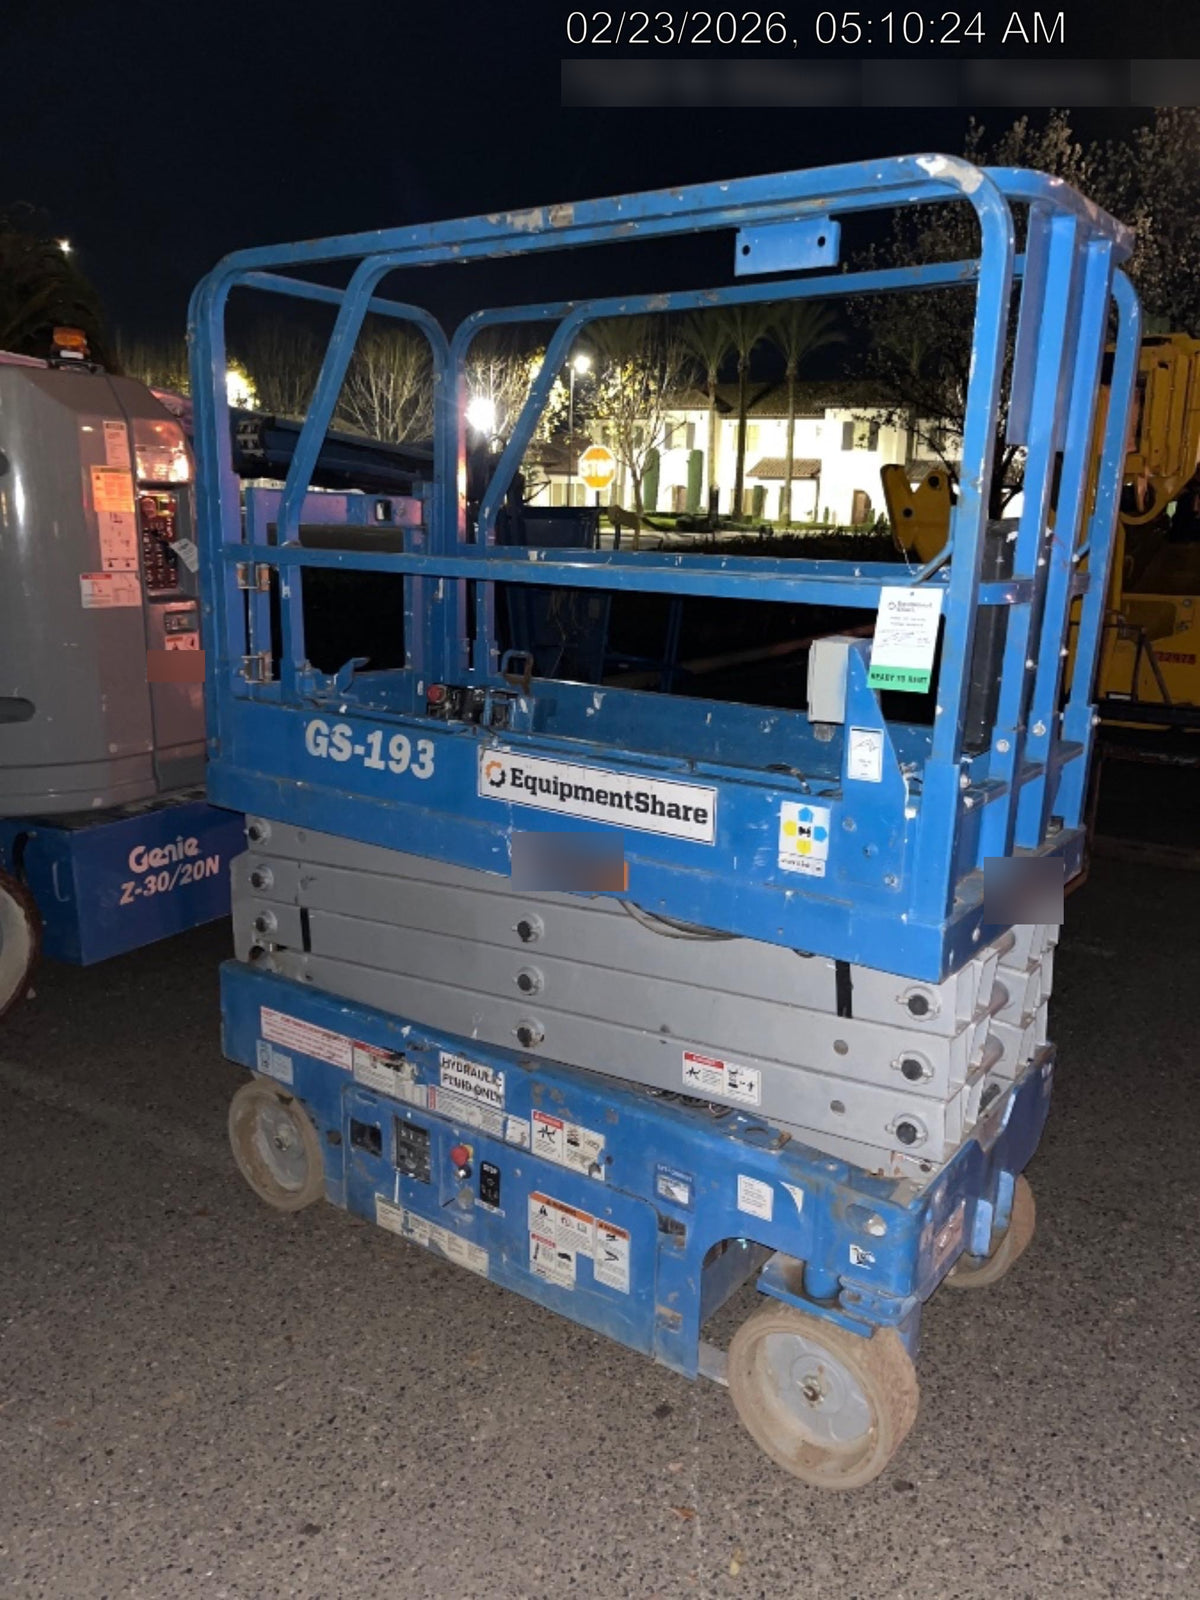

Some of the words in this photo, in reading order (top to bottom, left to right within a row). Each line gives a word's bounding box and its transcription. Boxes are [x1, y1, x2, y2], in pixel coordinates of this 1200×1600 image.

[305, 718, 436, 779] GS-193
[511, 767, 708, 825] EquipmentShare
[119, 854, 220, 905] Z-30/20N
[129, 835, 200, 873] Genie
